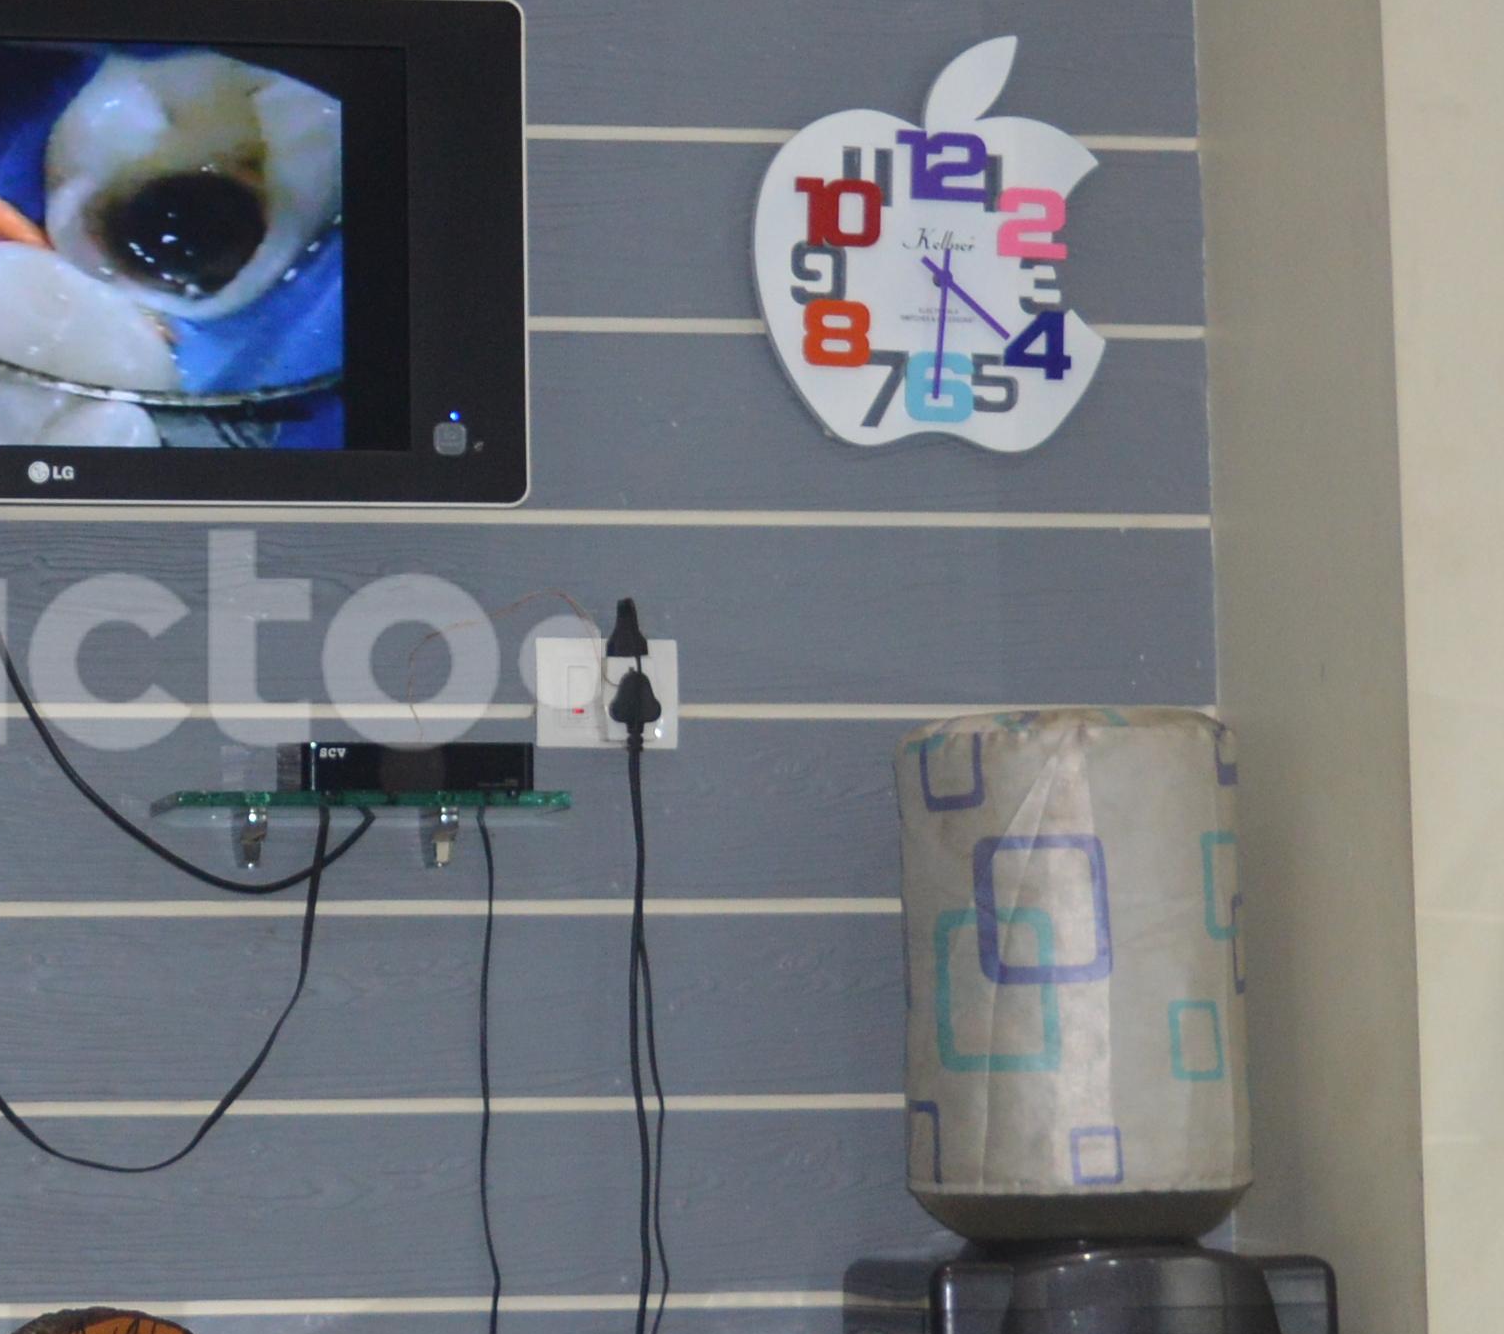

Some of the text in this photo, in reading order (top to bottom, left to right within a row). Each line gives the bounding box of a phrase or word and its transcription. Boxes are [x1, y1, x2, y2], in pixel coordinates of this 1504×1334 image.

[896, 129, 987, 202] 12
[795, 177, 882, 248] 10
[997, 188, 1067, 259] 2
[790, 241, 846, 305] 9
[1019, 258, 1061, 314] 3
[802, 299, 871, 367] 8
[1004, 310, 1071, 380] 4
[862, 350, 909, 427] 7
[905, 351, 974, 422] 6
[971, 353, 1018, 413] 5
[53, 466, 74, 479] LG
[320, 747, 346, 758] SCV
